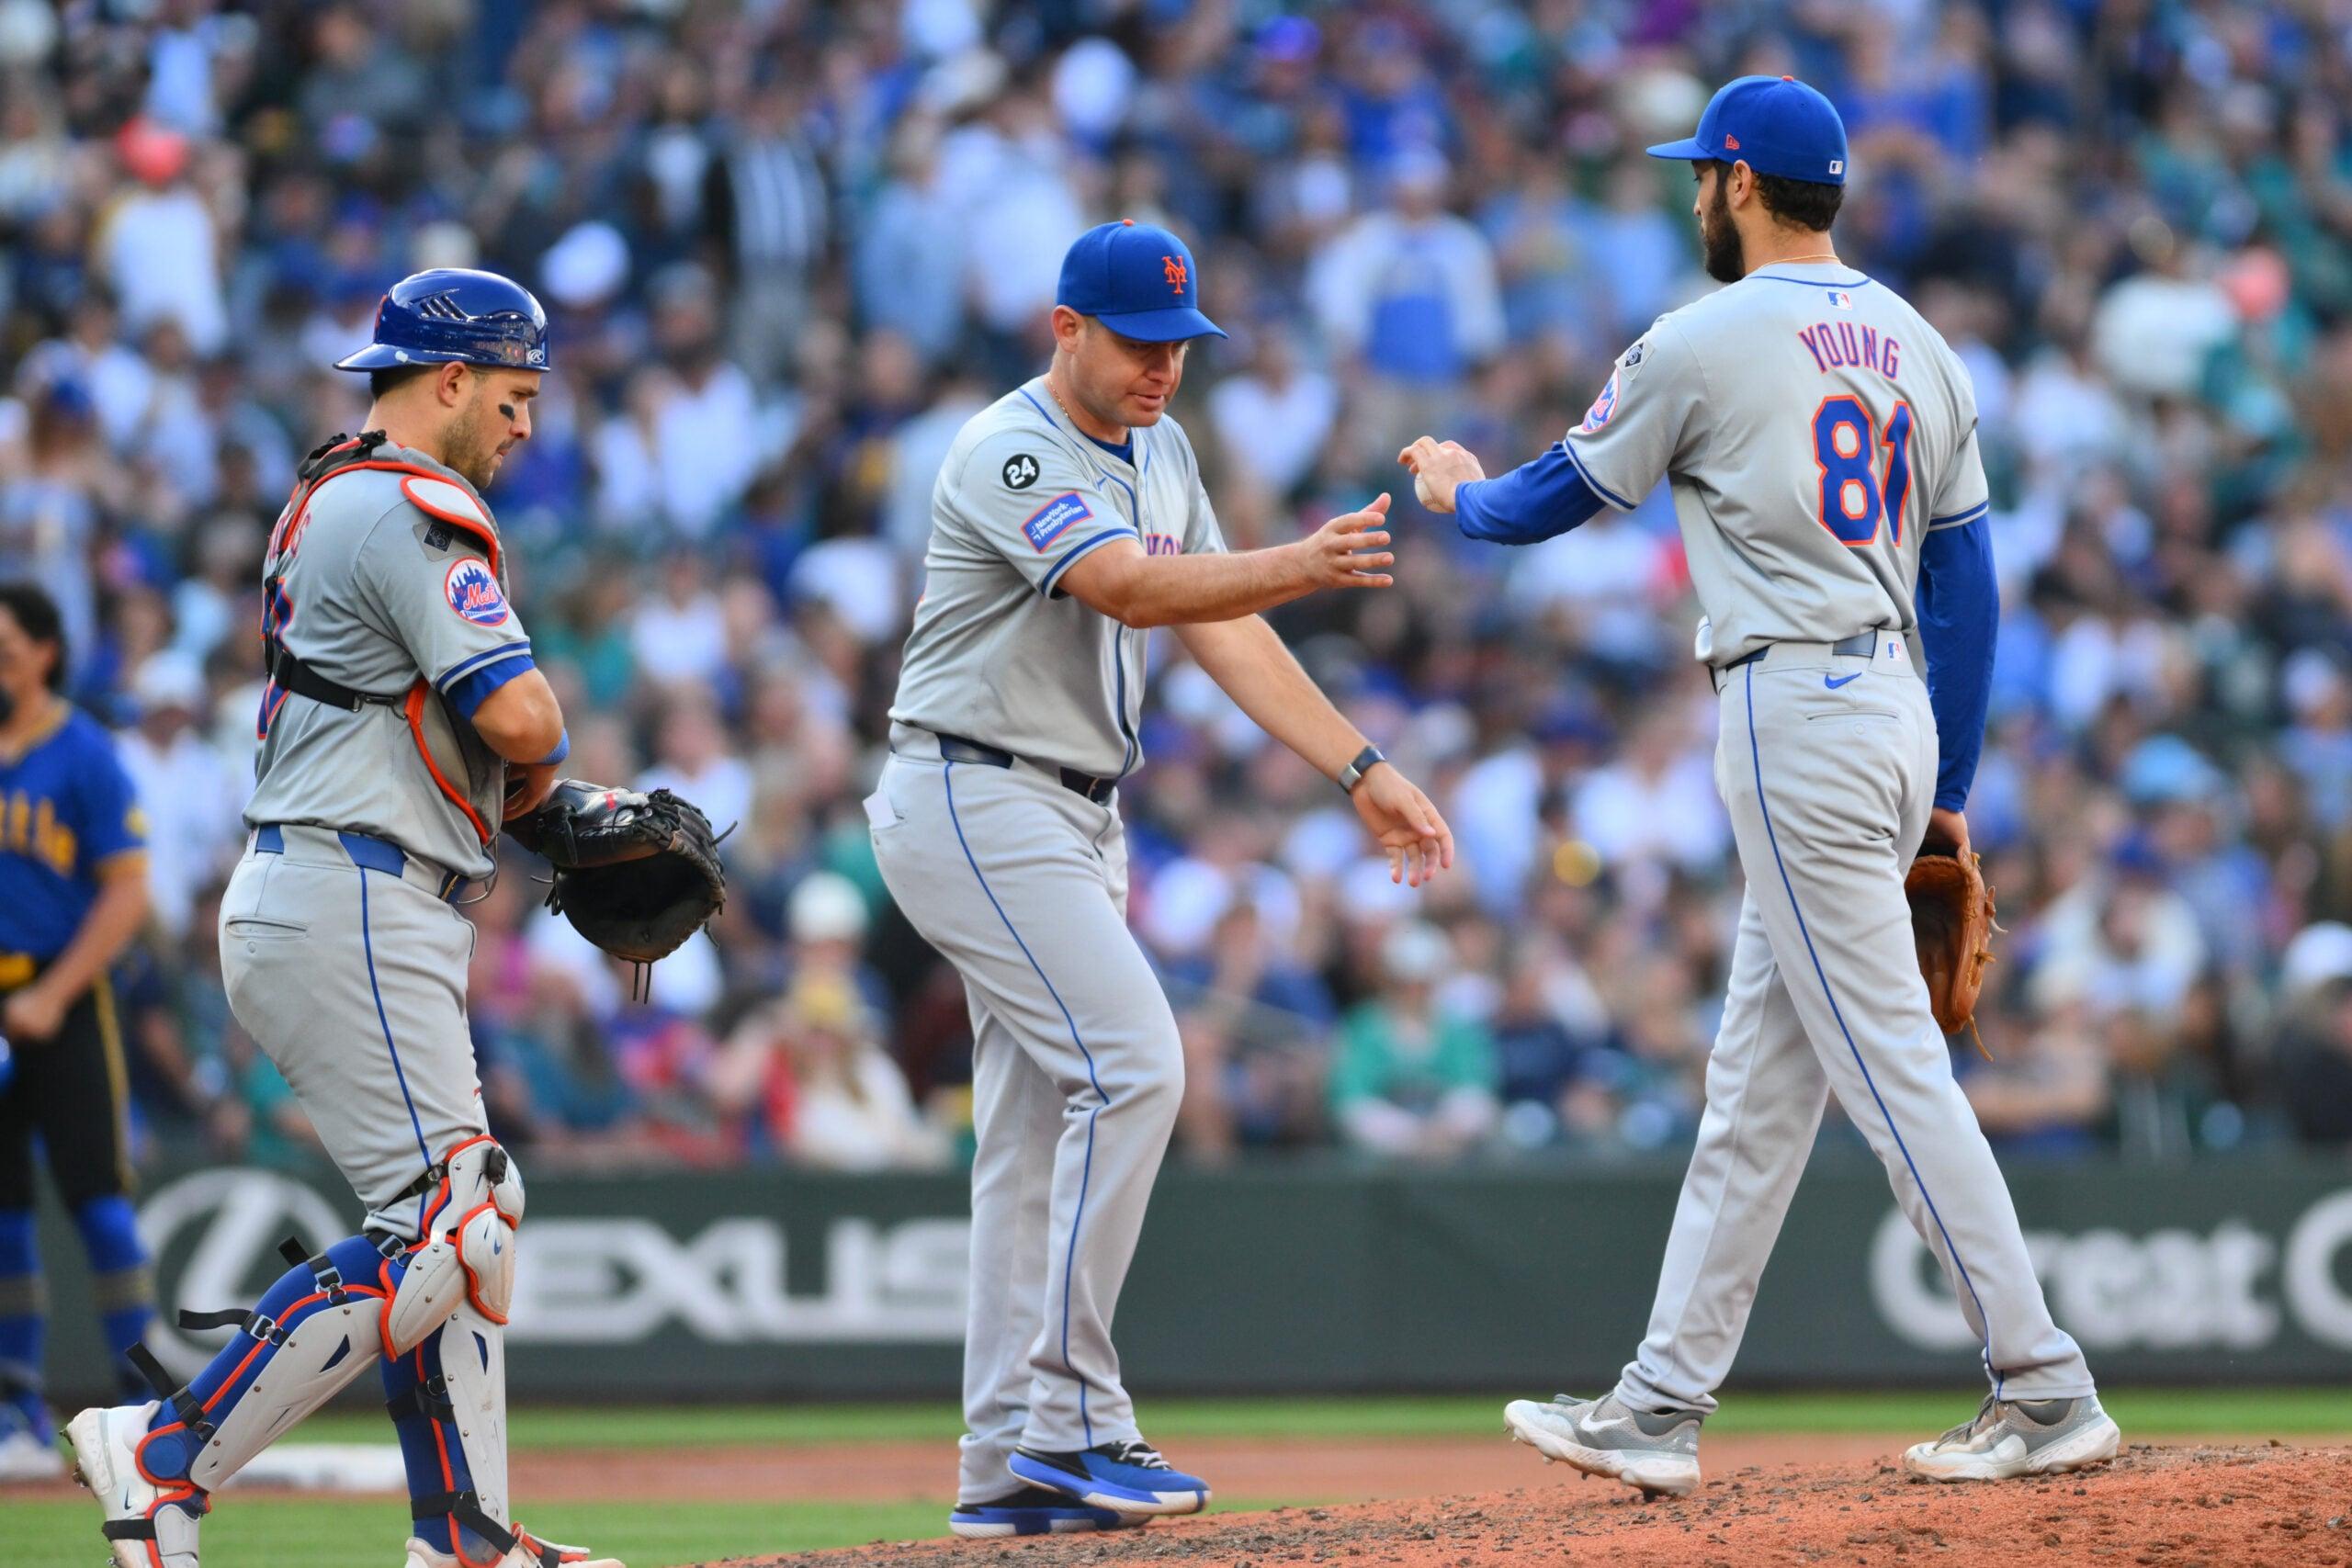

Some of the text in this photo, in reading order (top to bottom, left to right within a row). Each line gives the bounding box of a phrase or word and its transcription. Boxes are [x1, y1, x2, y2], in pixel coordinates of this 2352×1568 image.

[1798, 321, 1900, 380] YOUNG
[1006, 457, 1036, 487] 24
[1811, 394, 1914, 547] 81
[506, 1217, 971, 1342] EXUS
